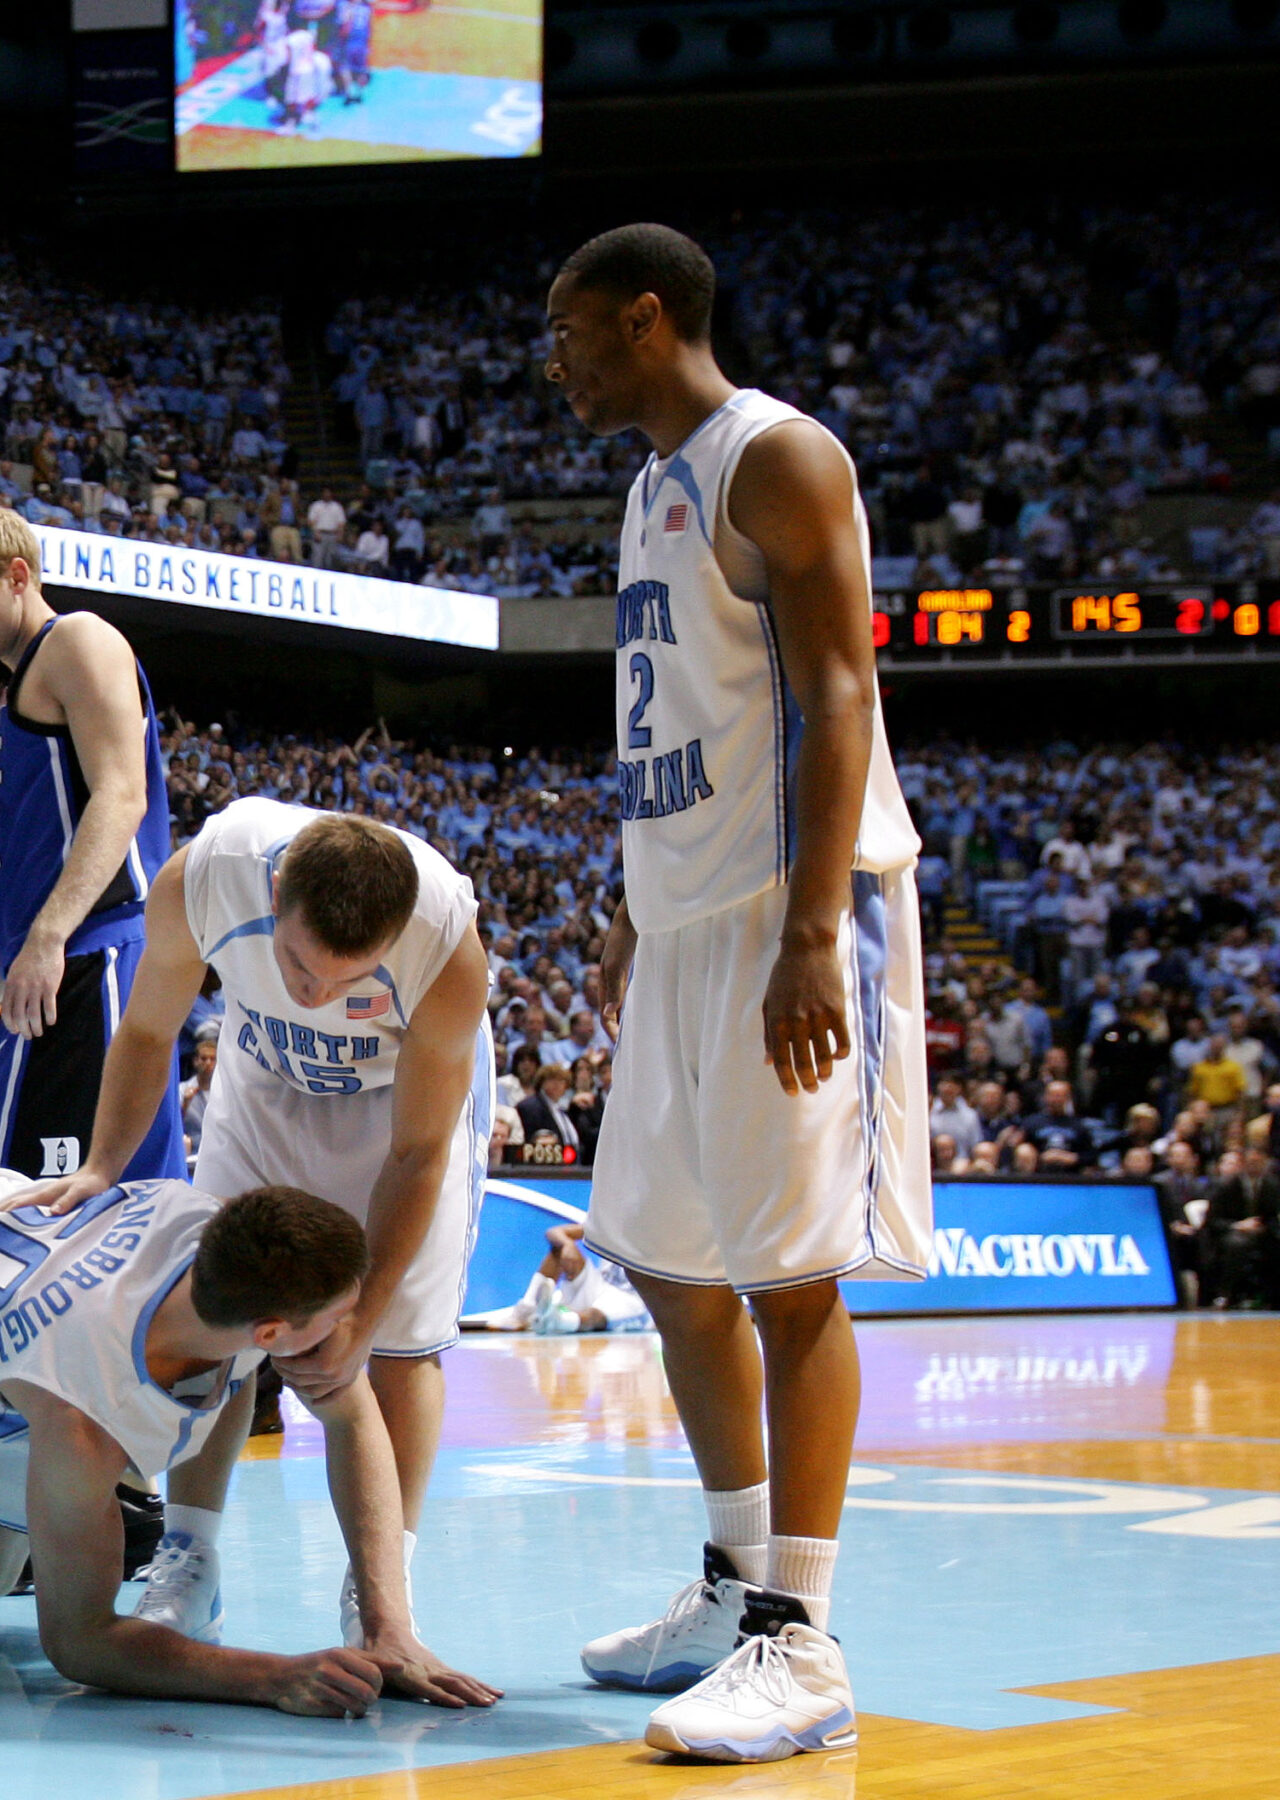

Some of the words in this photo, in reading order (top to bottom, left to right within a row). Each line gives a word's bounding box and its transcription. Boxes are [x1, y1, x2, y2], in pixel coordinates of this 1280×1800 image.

[41, 537, 115, 583] LINA
[134, 552, 339, 616] BASKETBALL
[628, 652, 654, 749] 2
[617, 738, 714, 820] ROLINA
[523, 1143, 563, 1164] POSS
[927, 1228, 1151, 1277] WACHOVIA
